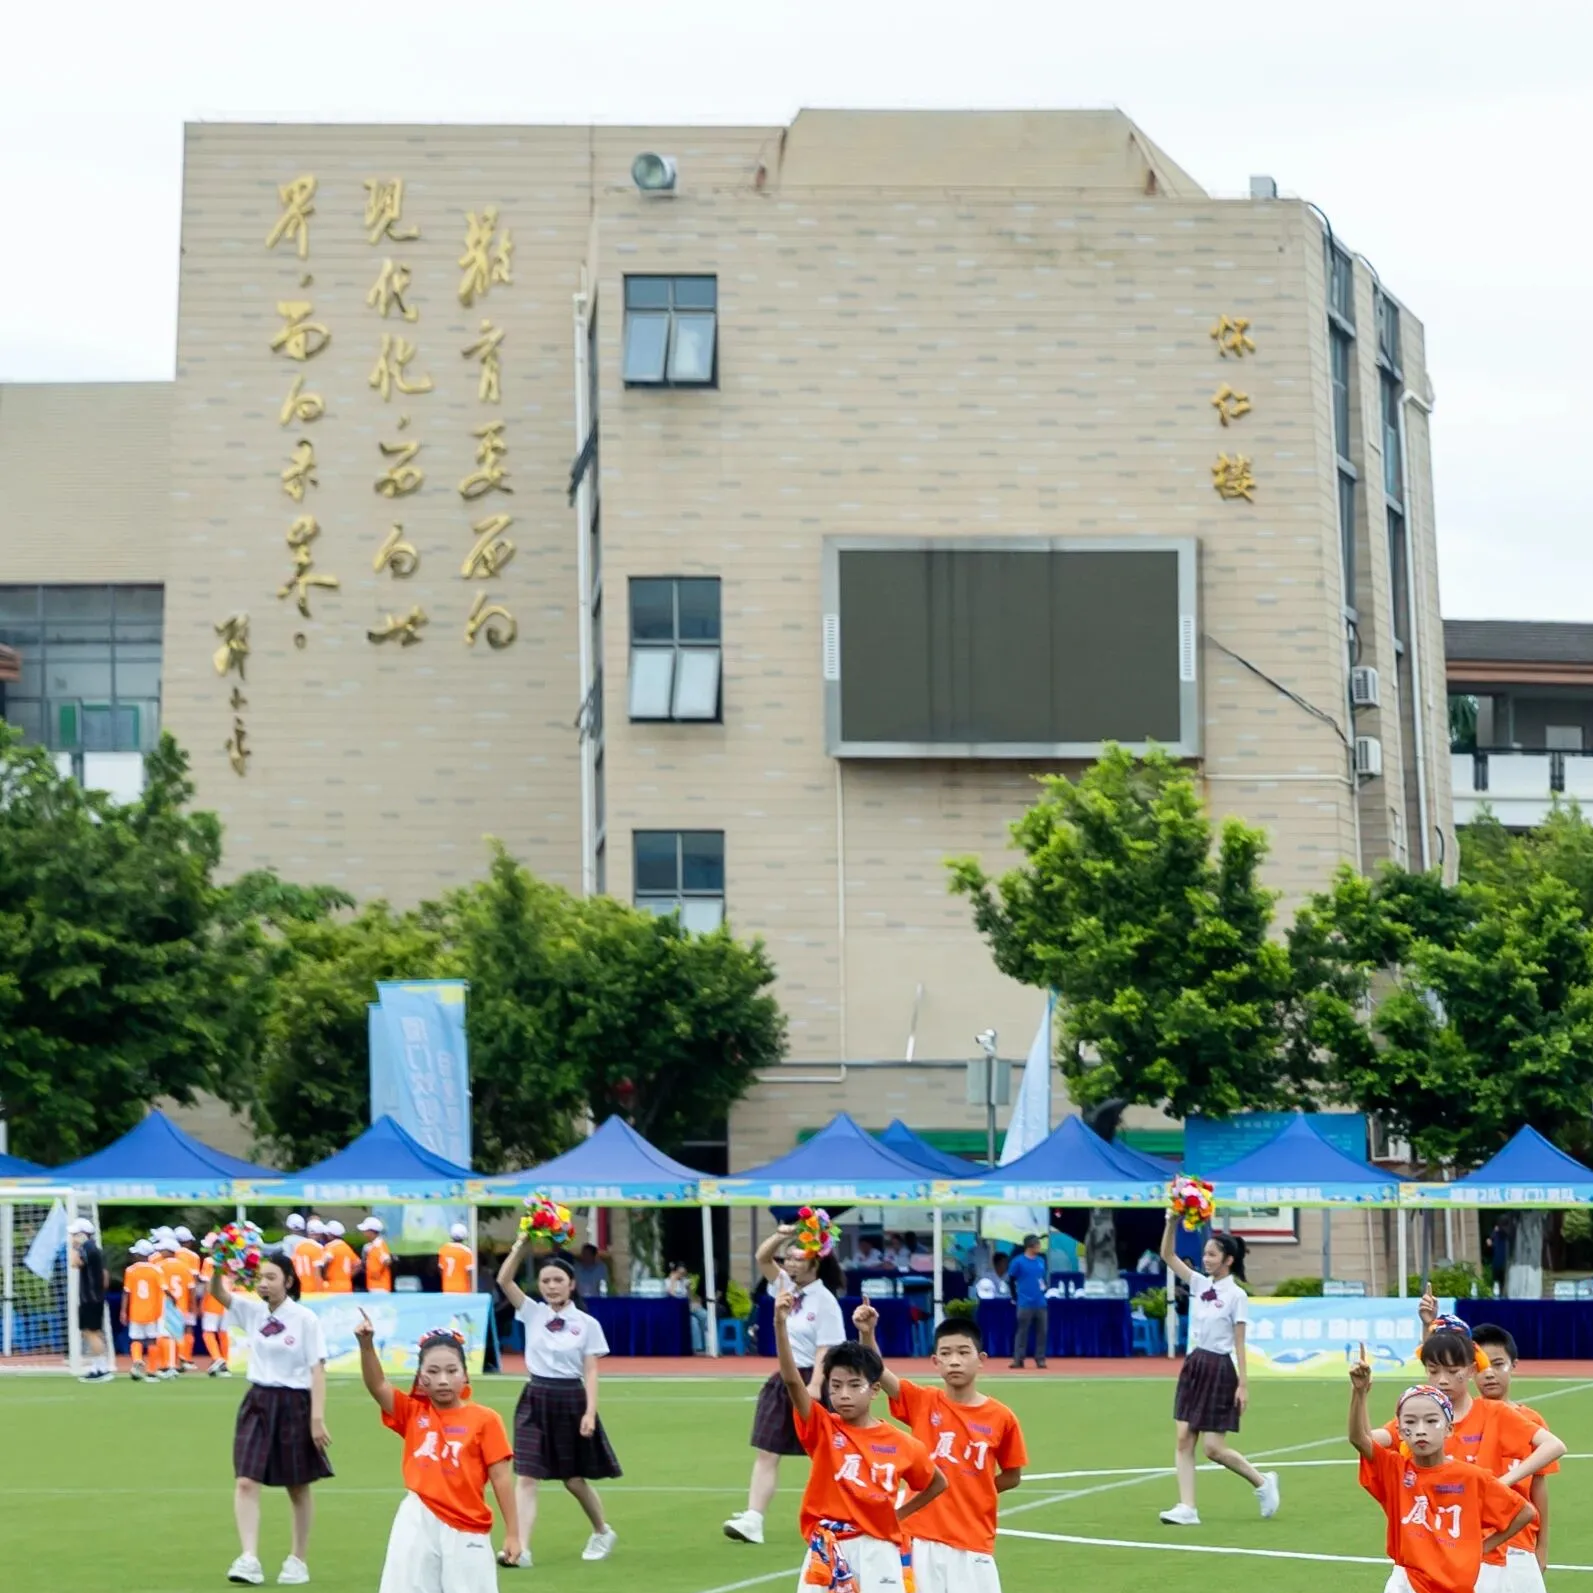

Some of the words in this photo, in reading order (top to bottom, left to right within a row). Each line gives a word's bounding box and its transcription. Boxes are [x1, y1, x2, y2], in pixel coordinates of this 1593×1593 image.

[929, 1431, 989, 1470] 厦门
[834, 1453, 896, 1492] 厦门
[1401, 1495, 1463, 1539] 厦门
